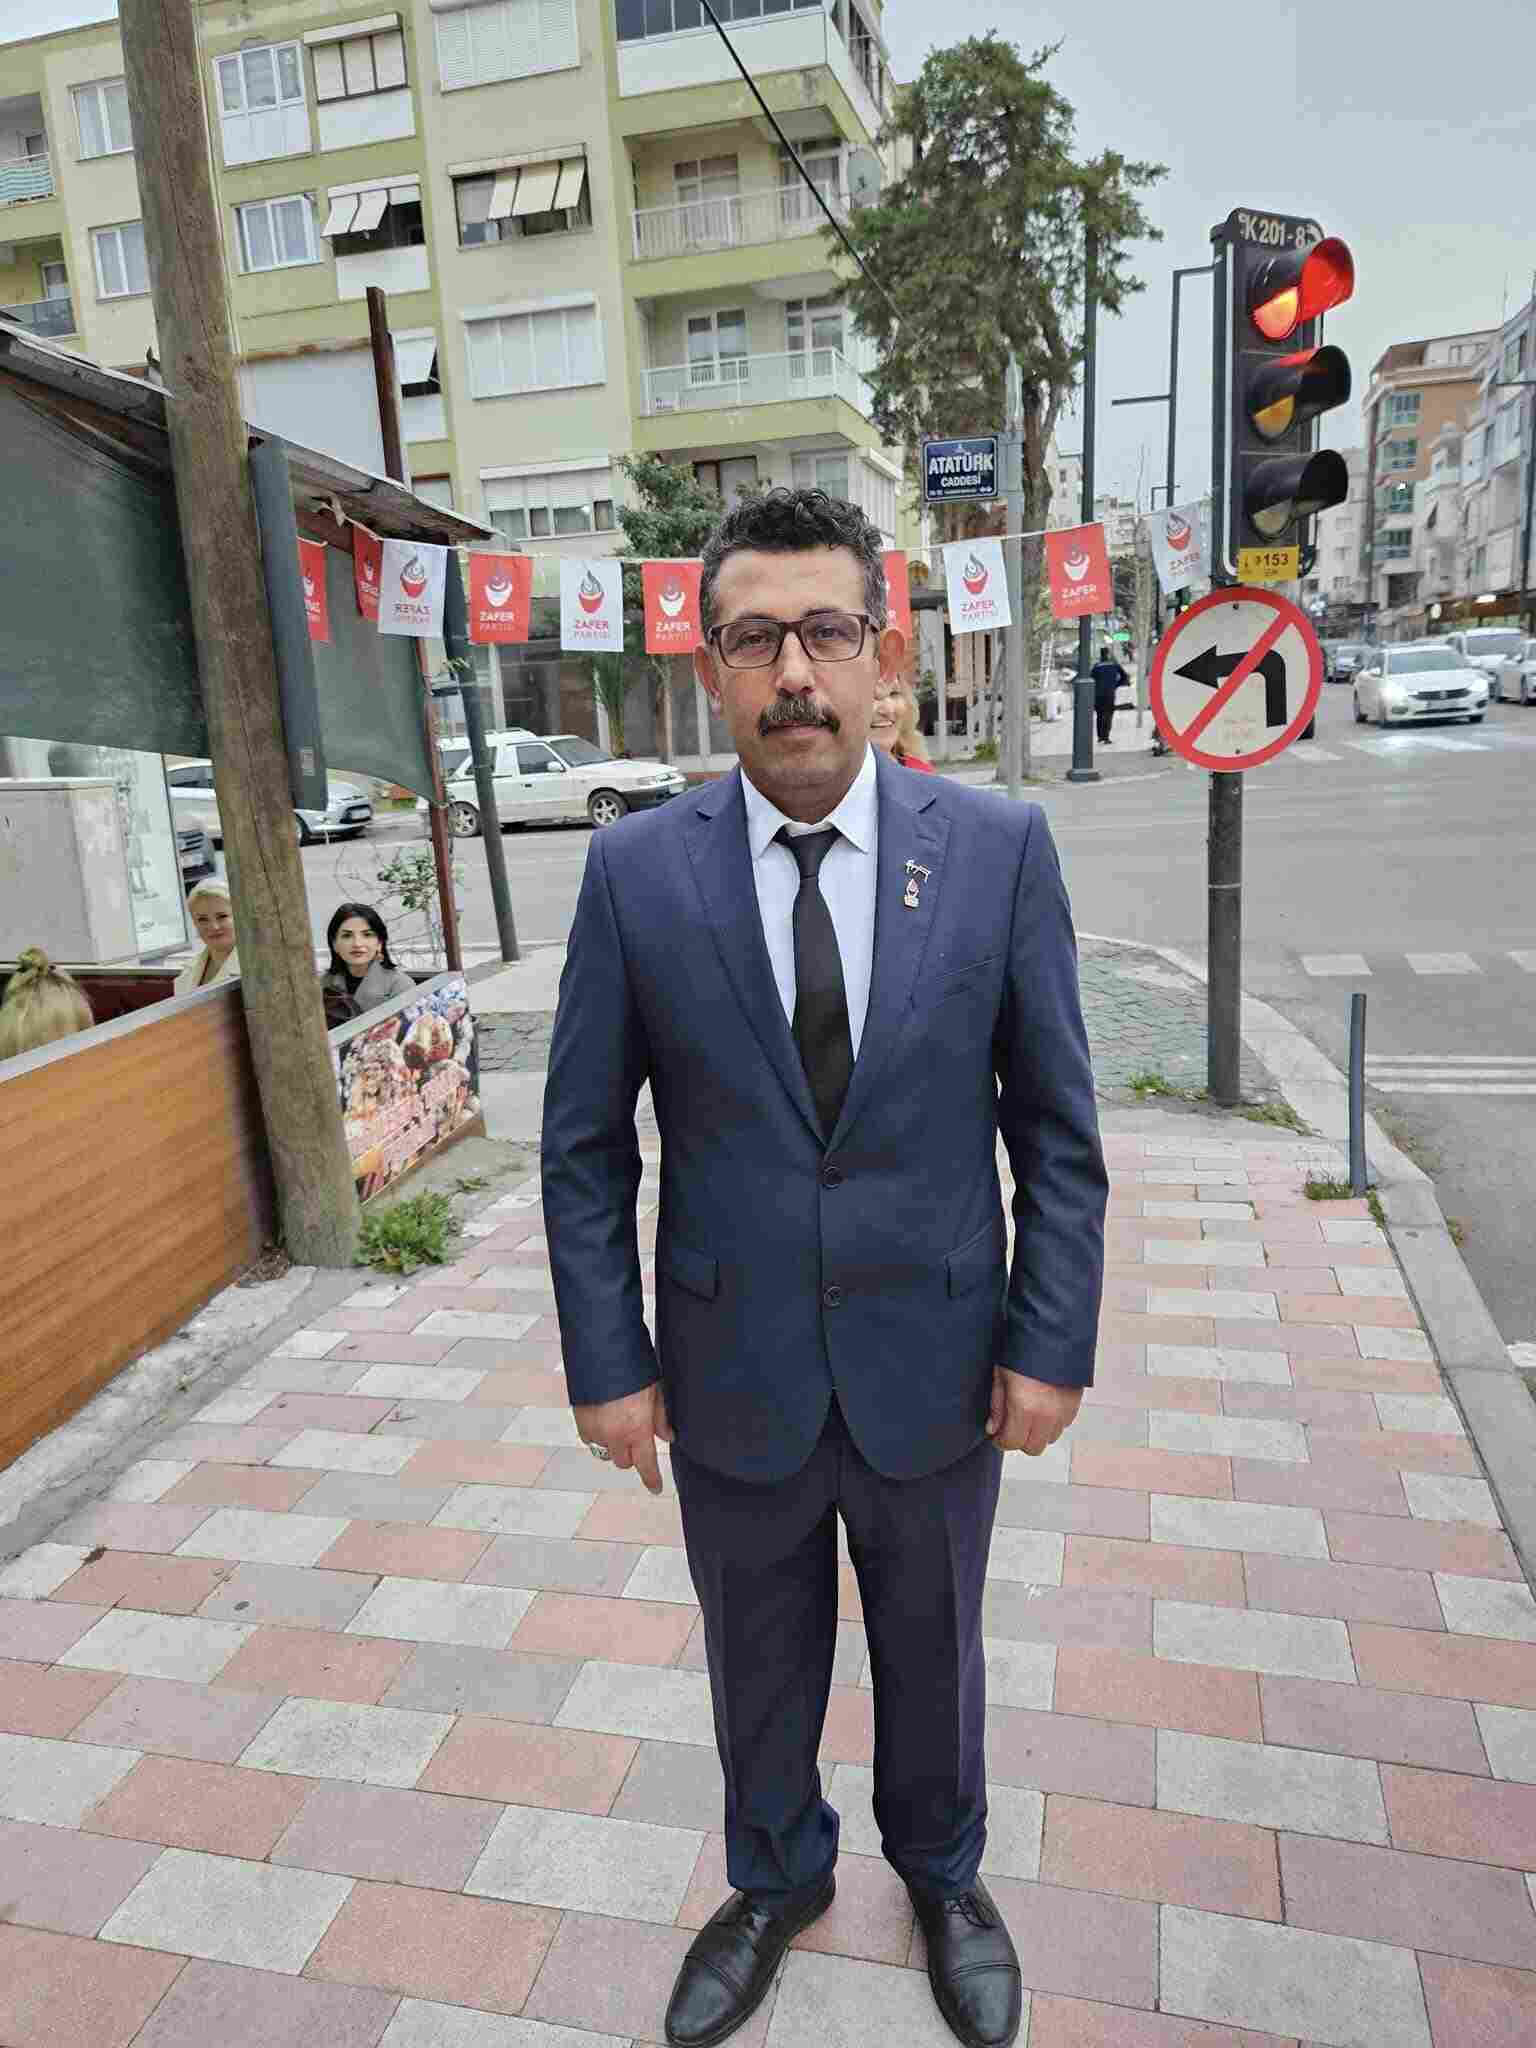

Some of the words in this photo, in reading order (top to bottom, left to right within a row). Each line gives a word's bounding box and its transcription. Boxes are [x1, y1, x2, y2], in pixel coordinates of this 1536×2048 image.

[929, 452, 993, 475] ATATÜRK
[941, 473, 981, 488] CADDESİ
[1263, 553, 1289, 567] 153
[1061, 584, 1097, 600] ZAFER
[960, 600, 996, 612] ZAFER
[479, 611, 515, 622] ZAFER
[574, 619, 609, 630] ZAFER
[655, 621, 691, 632] ZAFER
